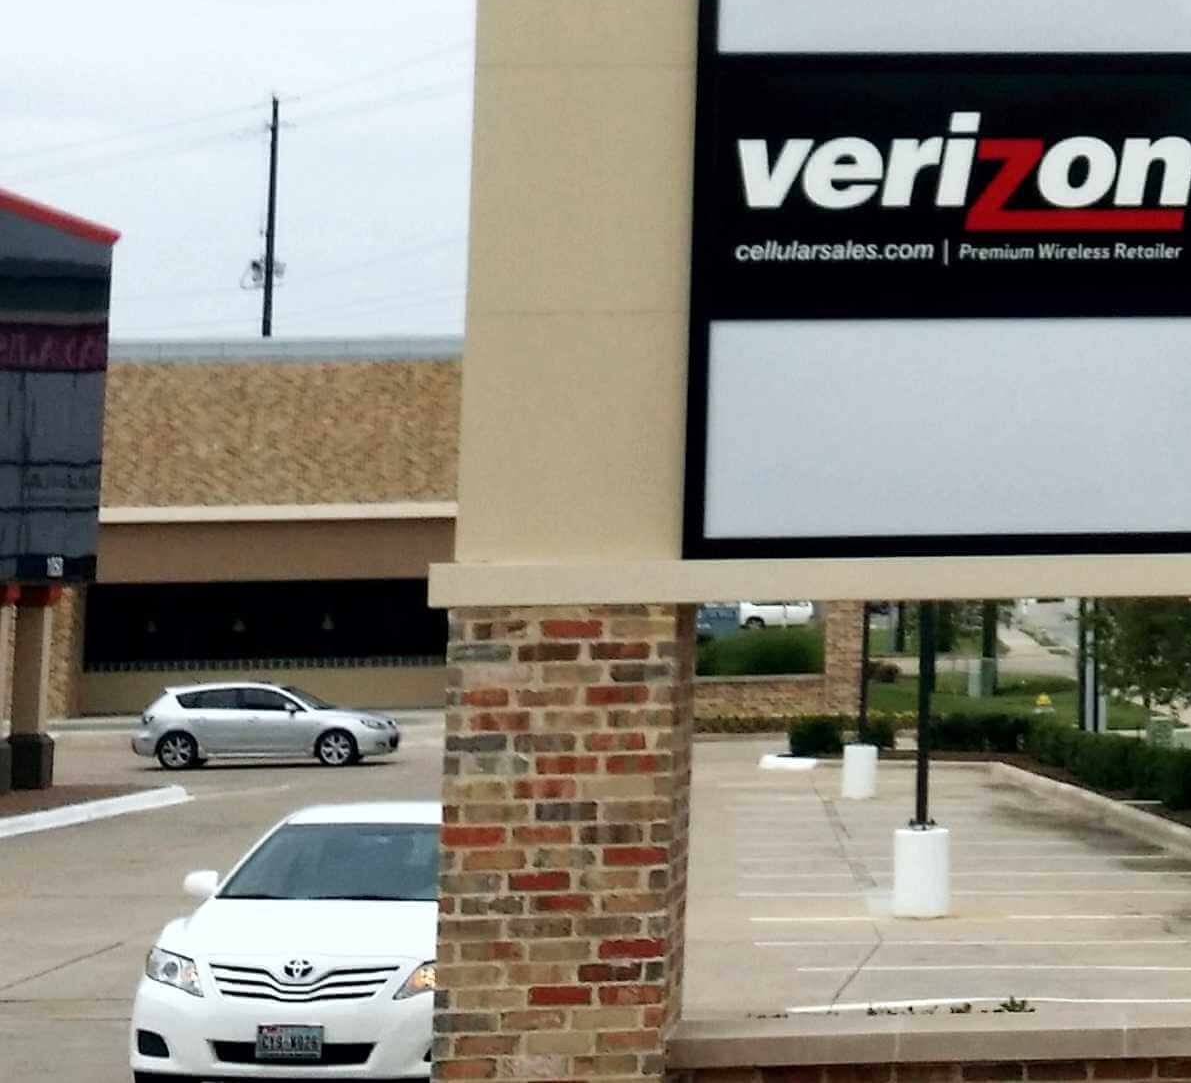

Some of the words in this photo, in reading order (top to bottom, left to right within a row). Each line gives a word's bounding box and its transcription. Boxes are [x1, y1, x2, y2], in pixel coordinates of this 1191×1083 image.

[735, 240, 935, 261] cellularsales.com
[959, 243, 1035, 260] Premium
[1038, 243, 1110, 260] Wireless
[1114, 242, 1182, 259] Retailer
